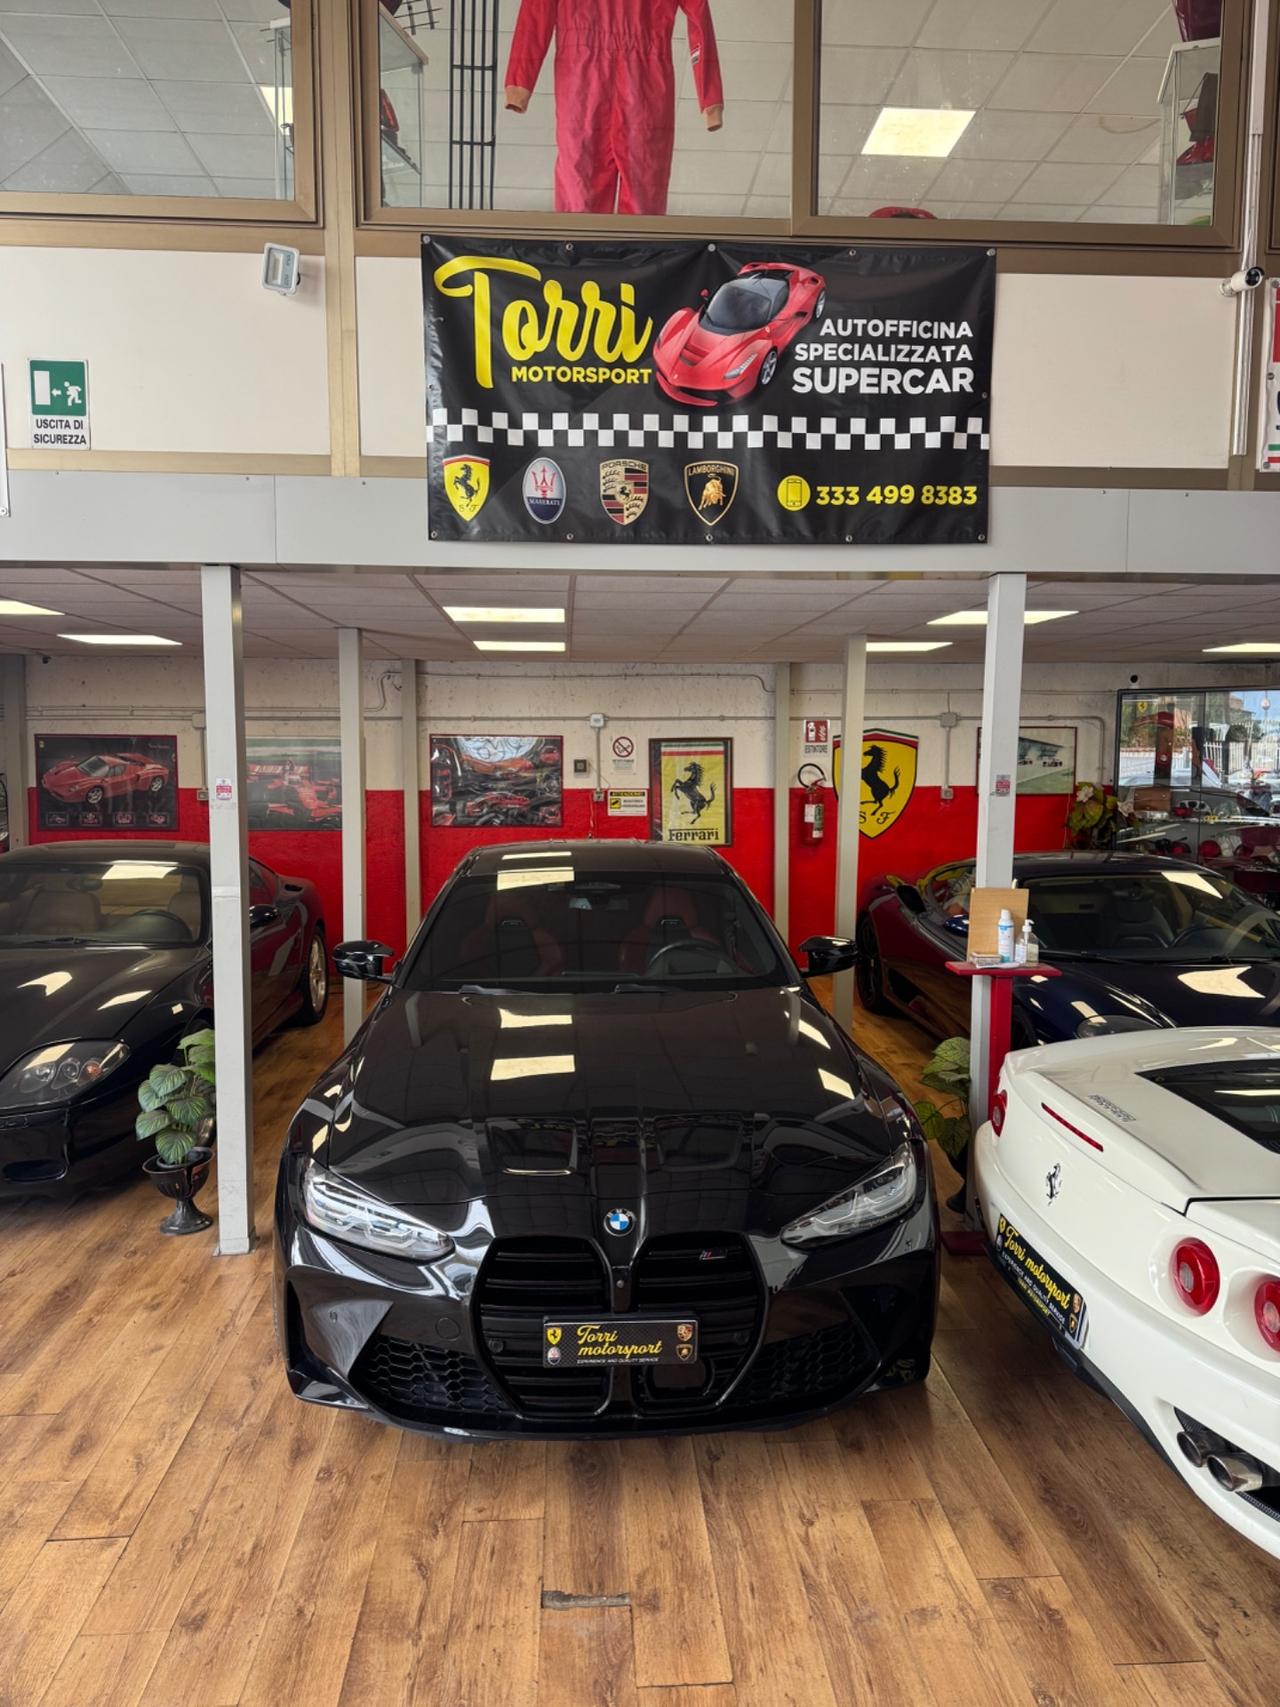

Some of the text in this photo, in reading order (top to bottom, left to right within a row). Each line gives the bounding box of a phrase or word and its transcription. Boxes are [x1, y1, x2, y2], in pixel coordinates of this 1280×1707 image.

[434, 256, 653, 388] Torri
[820, 318, 973, 339] AUTOFFICINA
[795, 343, 973, 363] SPECIALIZZATA
[511, 365, 652, 384] MOTORSPORT
[792, 366, 974, 395] SUPERCAR
[36, 418, 83, 429] USCITA DI
[33, 433, 87, 445] SICUREZZA
[816, 484, 977, 505] 333 499 8383
[668, 828, 720, 842] Ferrari
[1004, 1225, 1071, 1310] Torri motorsport
[576, 1325, 618, 1344] Torri
[577, 1341, 662, 1359] motorsport
